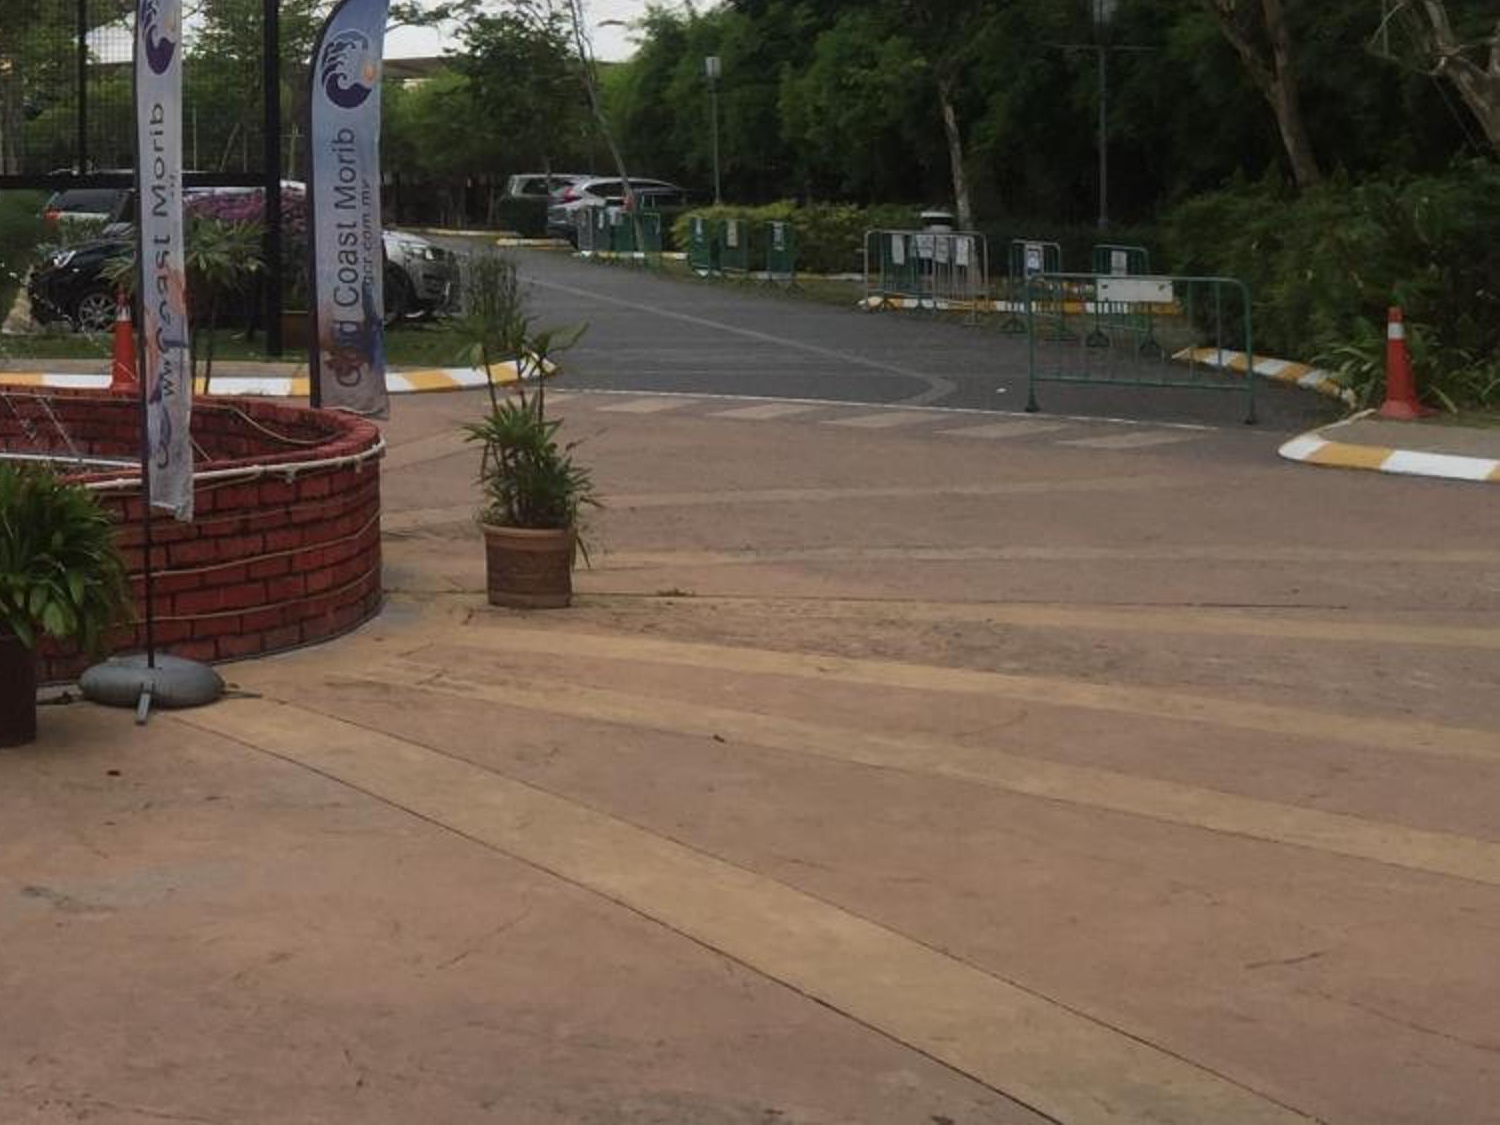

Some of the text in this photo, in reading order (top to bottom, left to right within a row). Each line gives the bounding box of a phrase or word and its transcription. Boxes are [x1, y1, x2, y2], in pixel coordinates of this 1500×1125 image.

[148, 103, 169, 217] Morib
[331, 126, 363, 388] Gd Coast Morib
